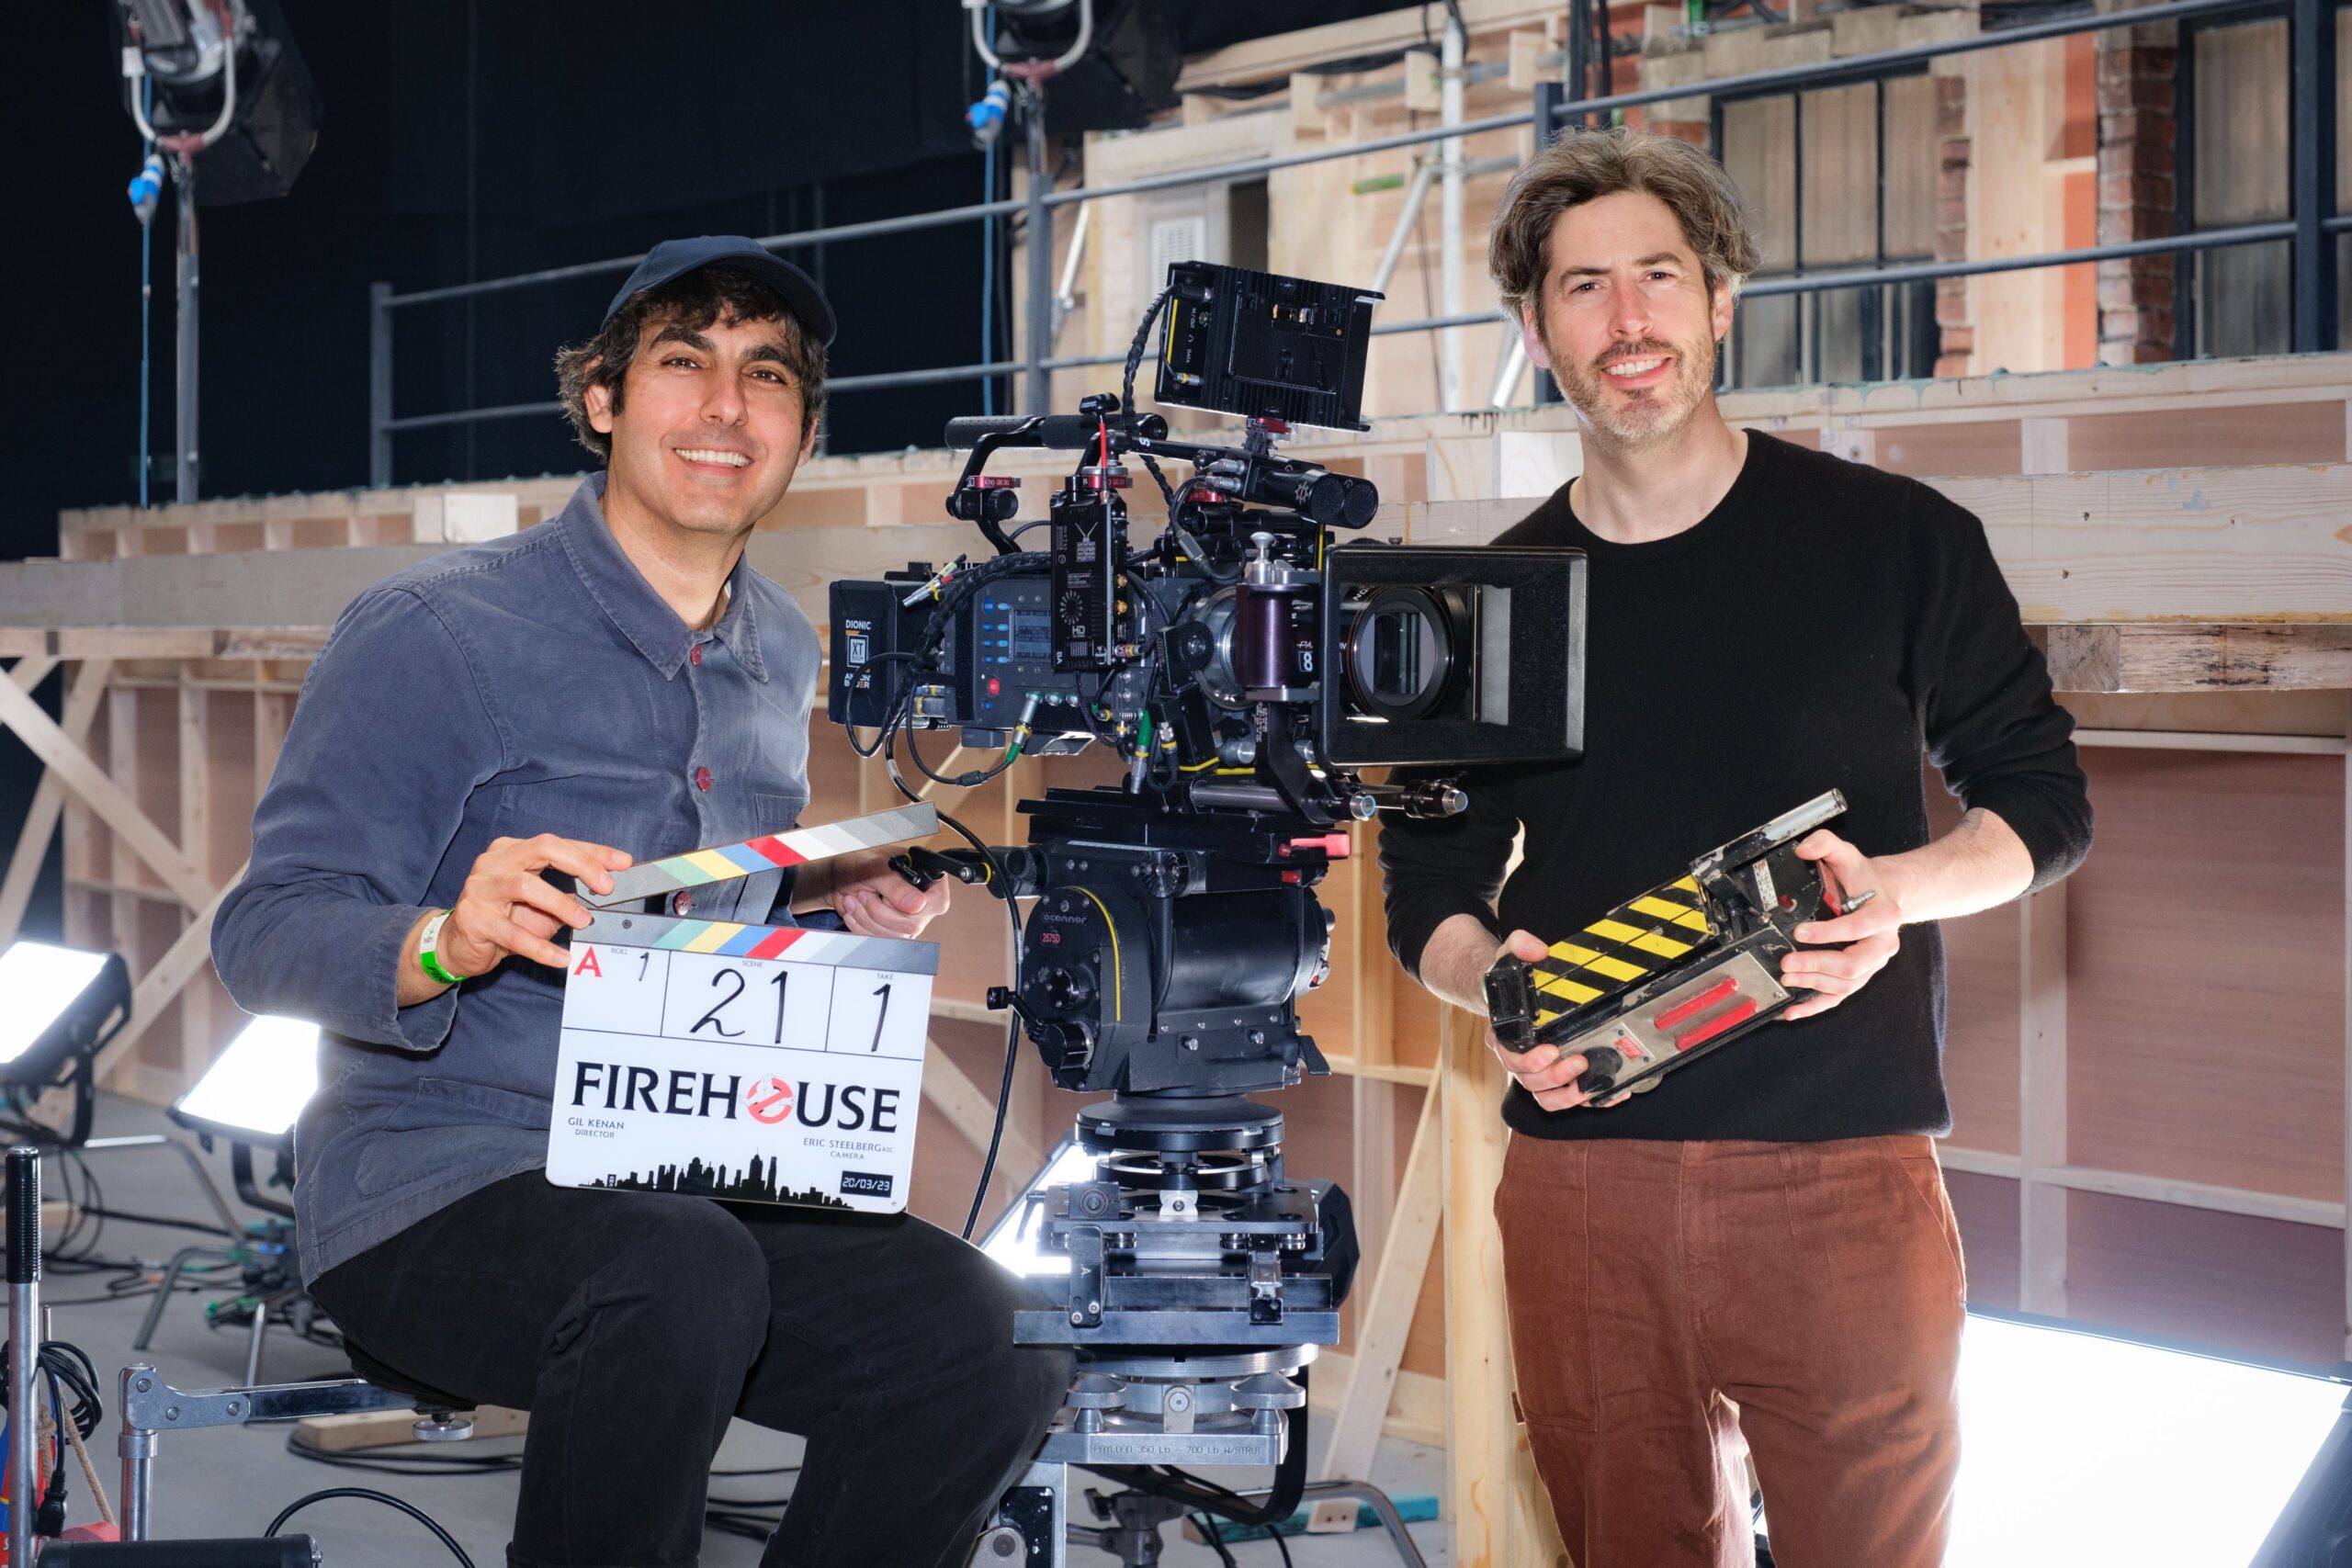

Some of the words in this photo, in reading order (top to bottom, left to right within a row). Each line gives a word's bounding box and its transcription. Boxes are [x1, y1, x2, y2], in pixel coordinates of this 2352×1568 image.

[845, 619, 872, 630] DIONIC
[852, 642, 864, 656] XT
[1042, 932, 1060, 944] 2575D
[610, 947, 628, 955] ROLL
[573, 945, 603, 978] A
[638, 952, 650, 982] 1
[741, 959, 763, 969] SCENE
[876, 972, 894, 980] TAKE
[689, 967, 788, 1044] 21
[871, 983, 891, 1053] 1
[568, 1117, 584, 1126] GIL
[588, 1119, 625, 1130] KENAN
[575, 1129, 615, 1139] DIRECTOR
[803, 1138, 826, 1147] ERIC
[829, 1139, 881, 1152] STEELBERG
[830, 1150, 865, 1160] CAMERA
[842, 1177, 890, 1191] 20/03/23
[1138, 1446, 1155, 1454] 350
[1159, 1446, 1170, 1454] Lb
[1187, 1446, 1204, 1454] 700
[1207, 1446, 1219, 1454] Lb
[1224, 1446, 1261, 1454] W/STRUT
